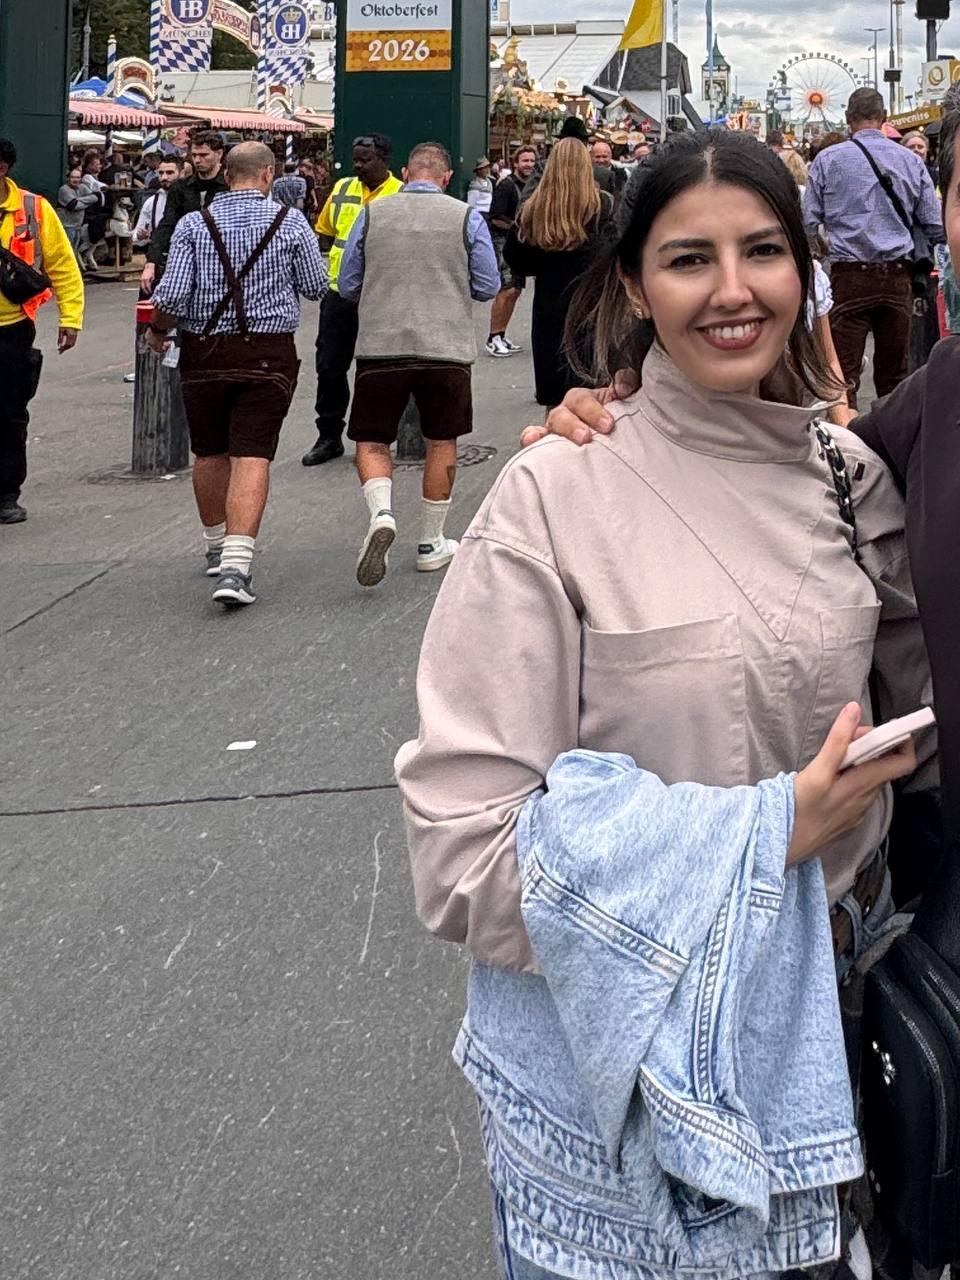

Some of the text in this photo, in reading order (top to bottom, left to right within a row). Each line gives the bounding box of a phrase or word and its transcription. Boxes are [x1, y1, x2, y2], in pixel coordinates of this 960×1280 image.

[179, 0, 203, 18] HB
[361, 3, 438, 19] Oktoberfest
[368, 39, 430, 62] 2026
